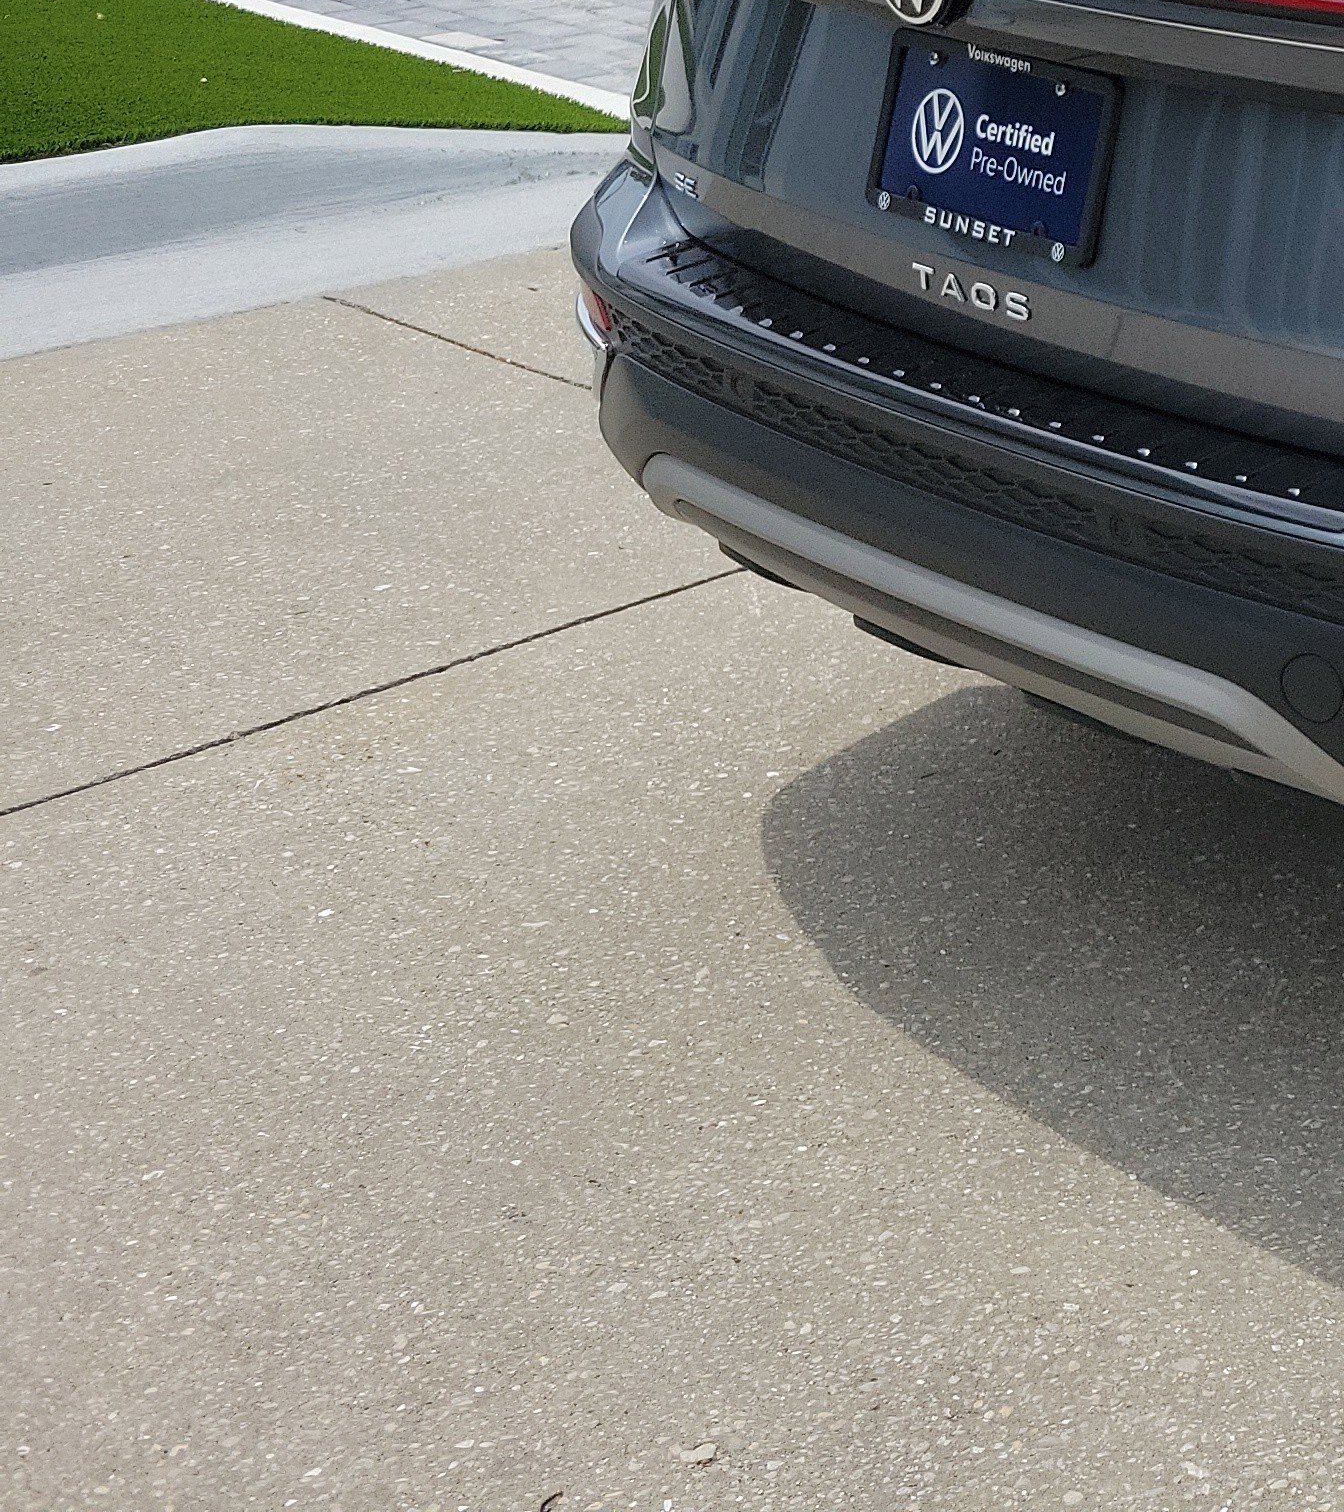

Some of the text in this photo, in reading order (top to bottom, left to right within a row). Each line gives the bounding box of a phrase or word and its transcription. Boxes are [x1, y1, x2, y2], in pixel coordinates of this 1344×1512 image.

[967, 43, 1031, 73] Volkswagen
[911, 88, 964, 175] VW
[976, 114, 1056, 156] Certified
[970, 147, 1067, 196] Pre-Owned
[924, 206, 1015, 247] SUNSET
[912, 262, 1031, 322] TAOS
